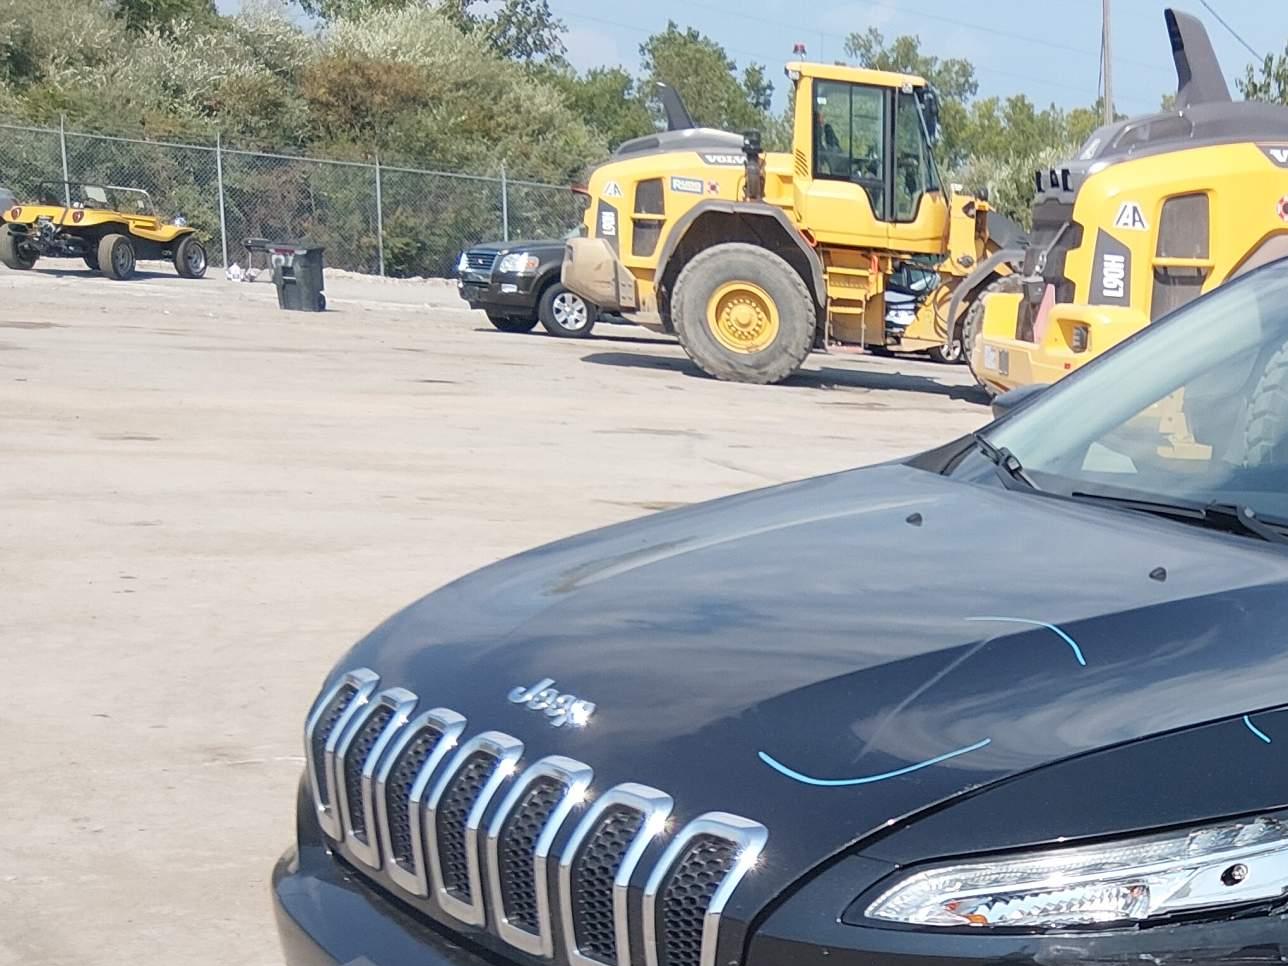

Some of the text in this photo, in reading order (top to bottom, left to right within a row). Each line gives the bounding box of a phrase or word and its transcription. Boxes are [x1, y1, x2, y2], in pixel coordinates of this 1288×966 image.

[705, 153, 747, 164] VOLV
[1102, 253, 1125, 298] L90H
[507, 677, 597, 728] Jeep
